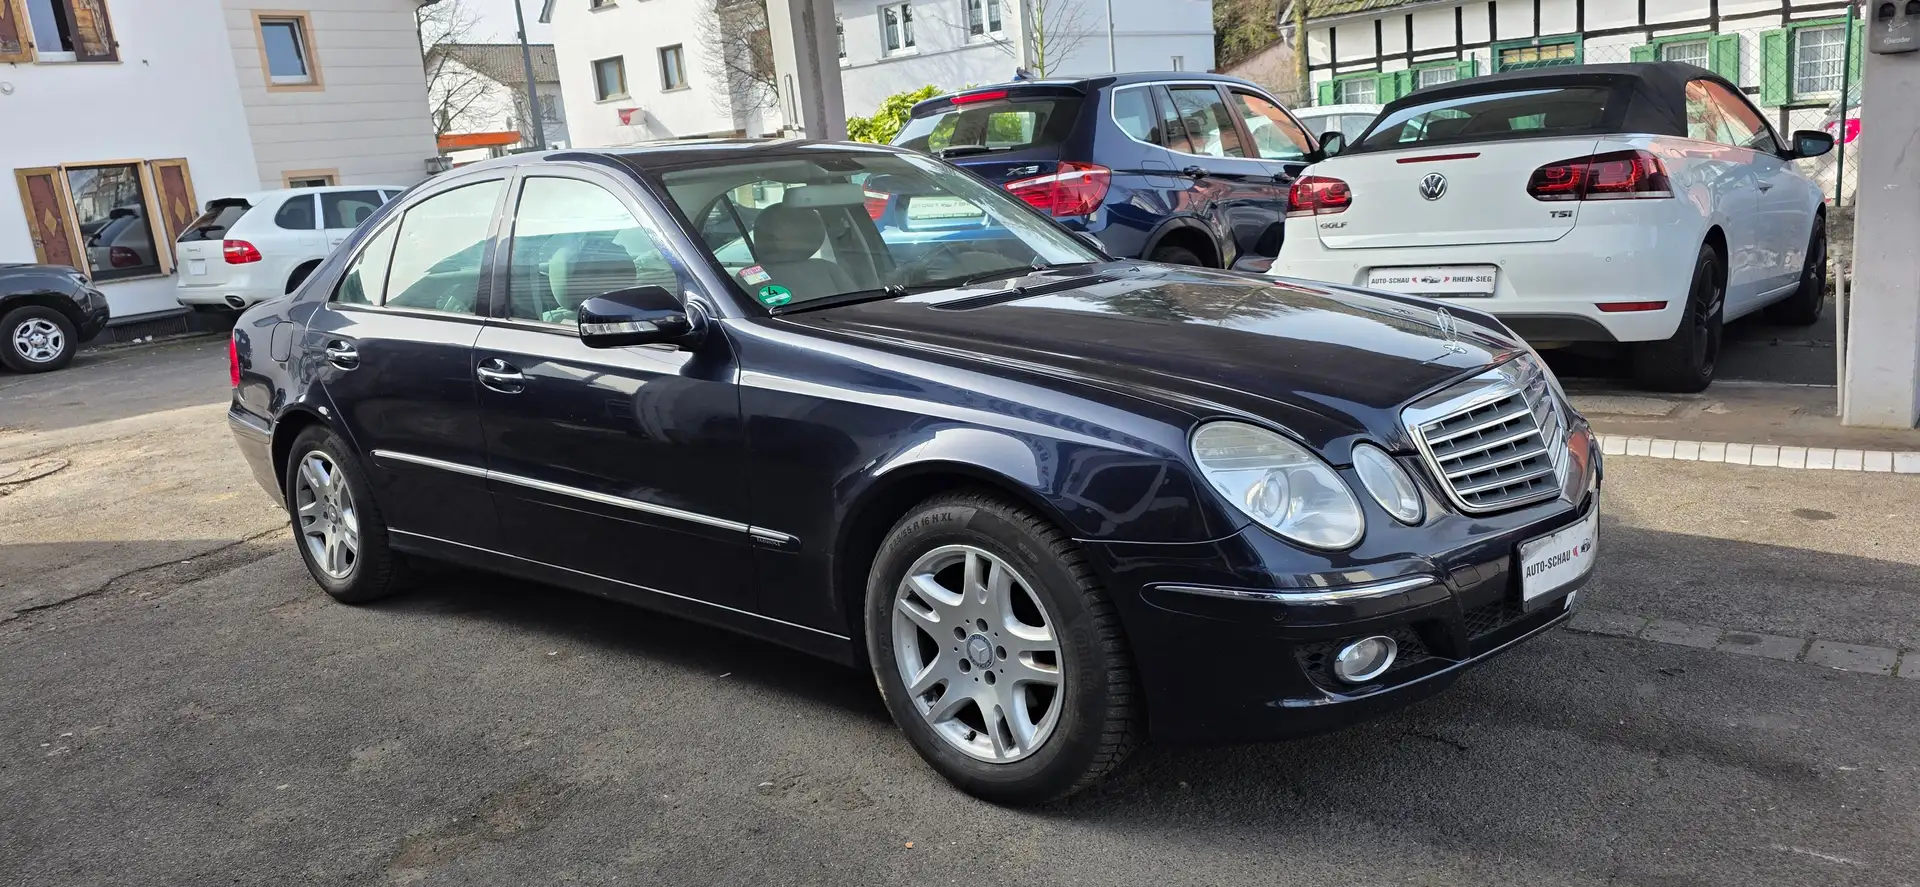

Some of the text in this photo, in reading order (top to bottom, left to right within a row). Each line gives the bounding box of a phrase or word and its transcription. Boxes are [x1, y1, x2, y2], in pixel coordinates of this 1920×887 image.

[1006, 165, 1039, 176] X3
[921, 517, 930, 528] 16
[932, 514, 939, 523] H
[941, 512, 953, 522] XL
[1525, 549, 1571, 579] AUTO-SCHAU
